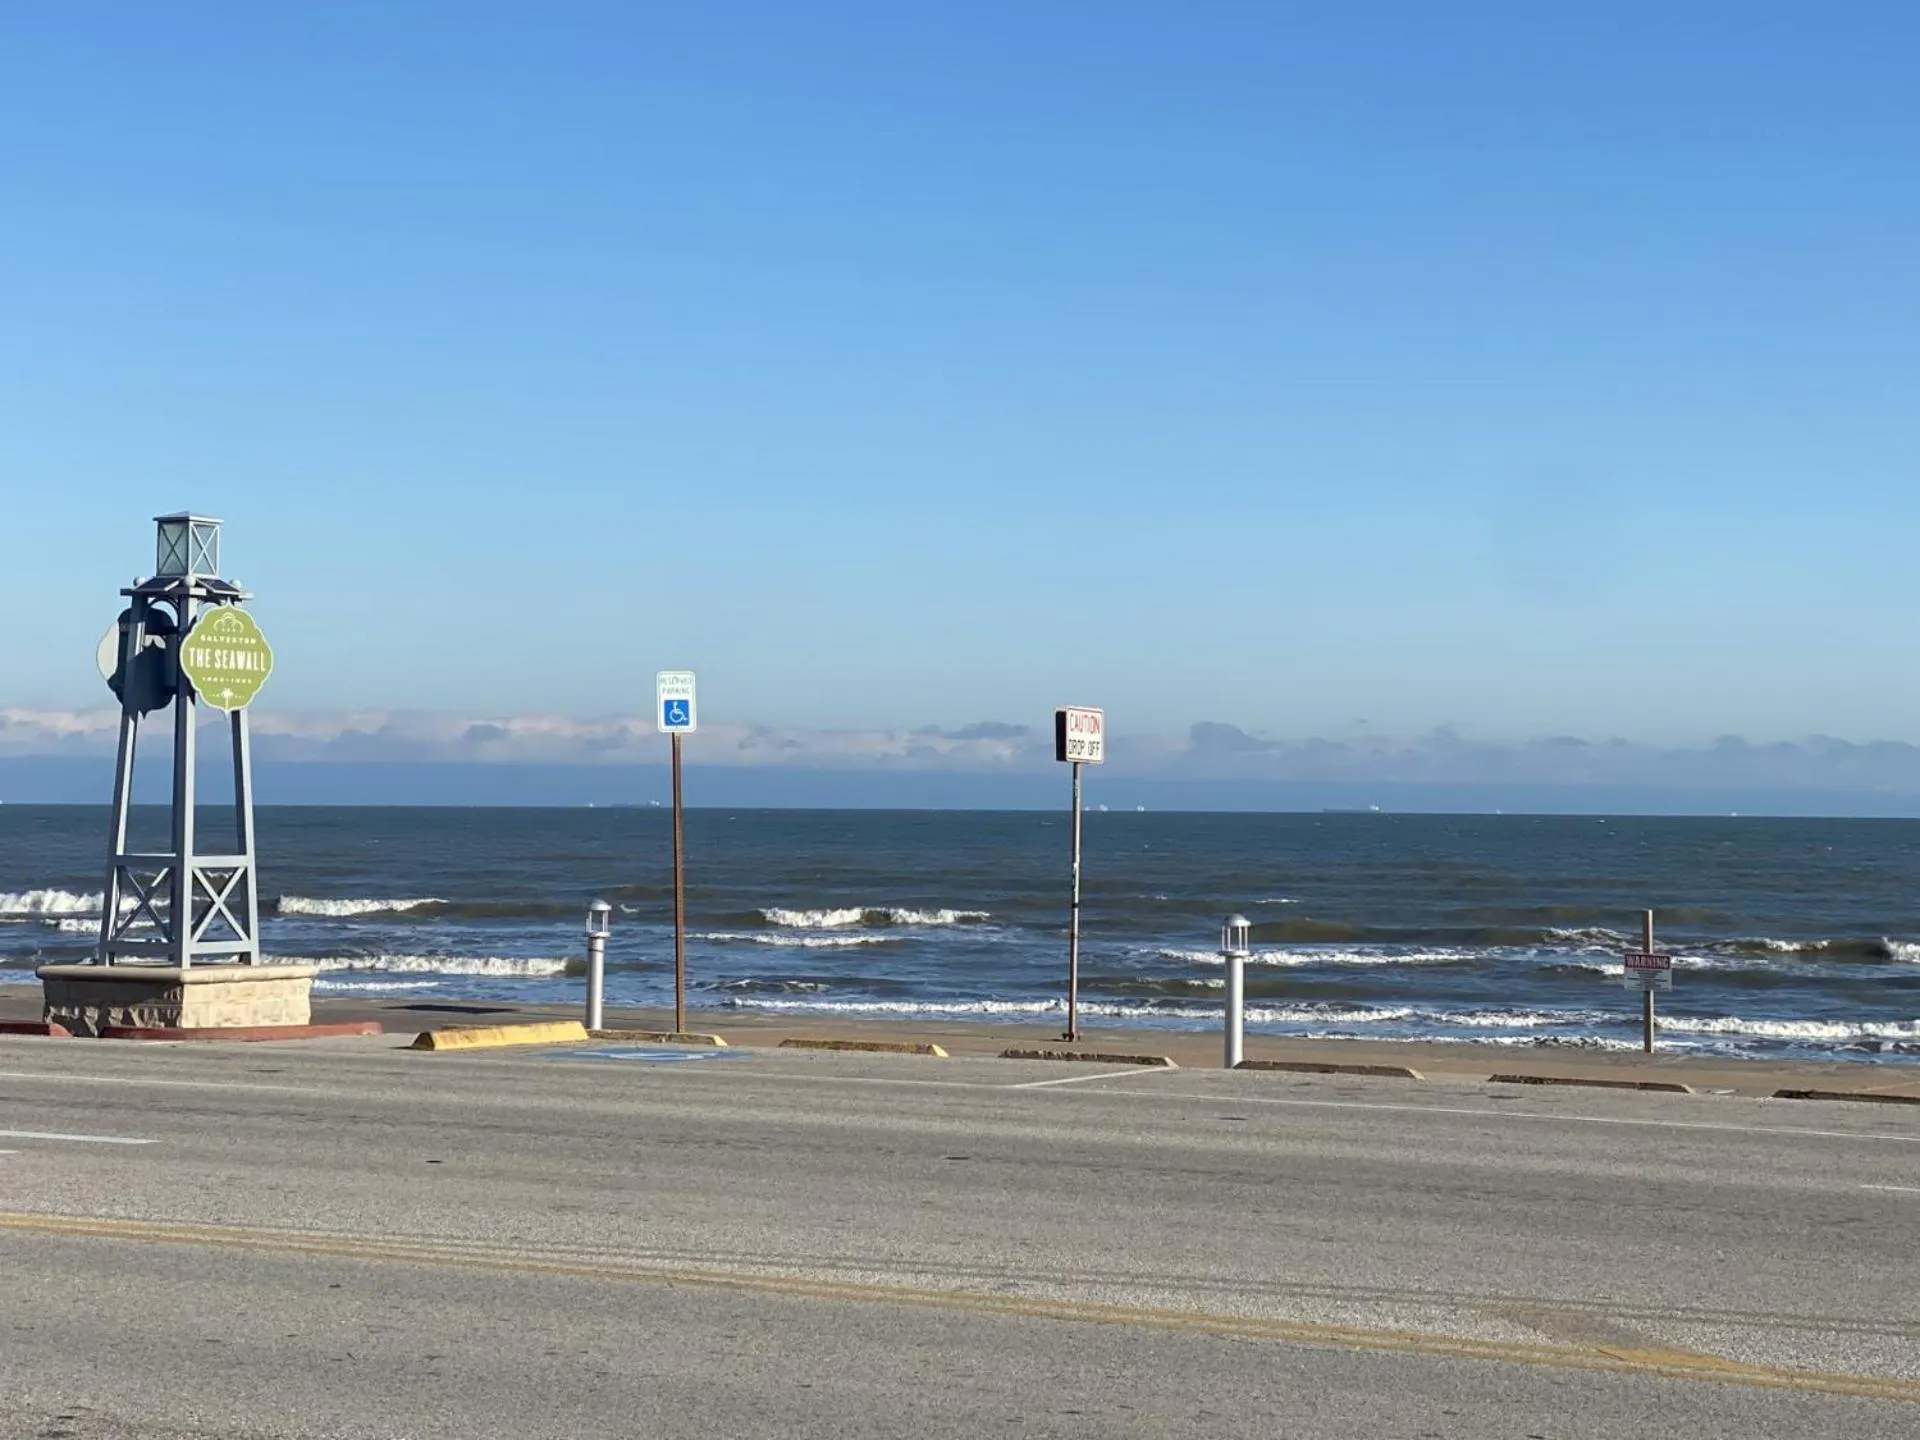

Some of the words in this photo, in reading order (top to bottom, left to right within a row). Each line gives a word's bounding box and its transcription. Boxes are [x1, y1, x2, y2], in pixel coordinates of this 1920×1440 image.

[189, 647, 212, 669] THE
[214, 648, 266, 673] SEAWALL
[1069, 712, 1100, 734] CAUTION
[1068, 739, 1085, 755] DROP
[1088, 741, 1100, 756] OFF
[1627, 955, 1669, 969] WARNING
